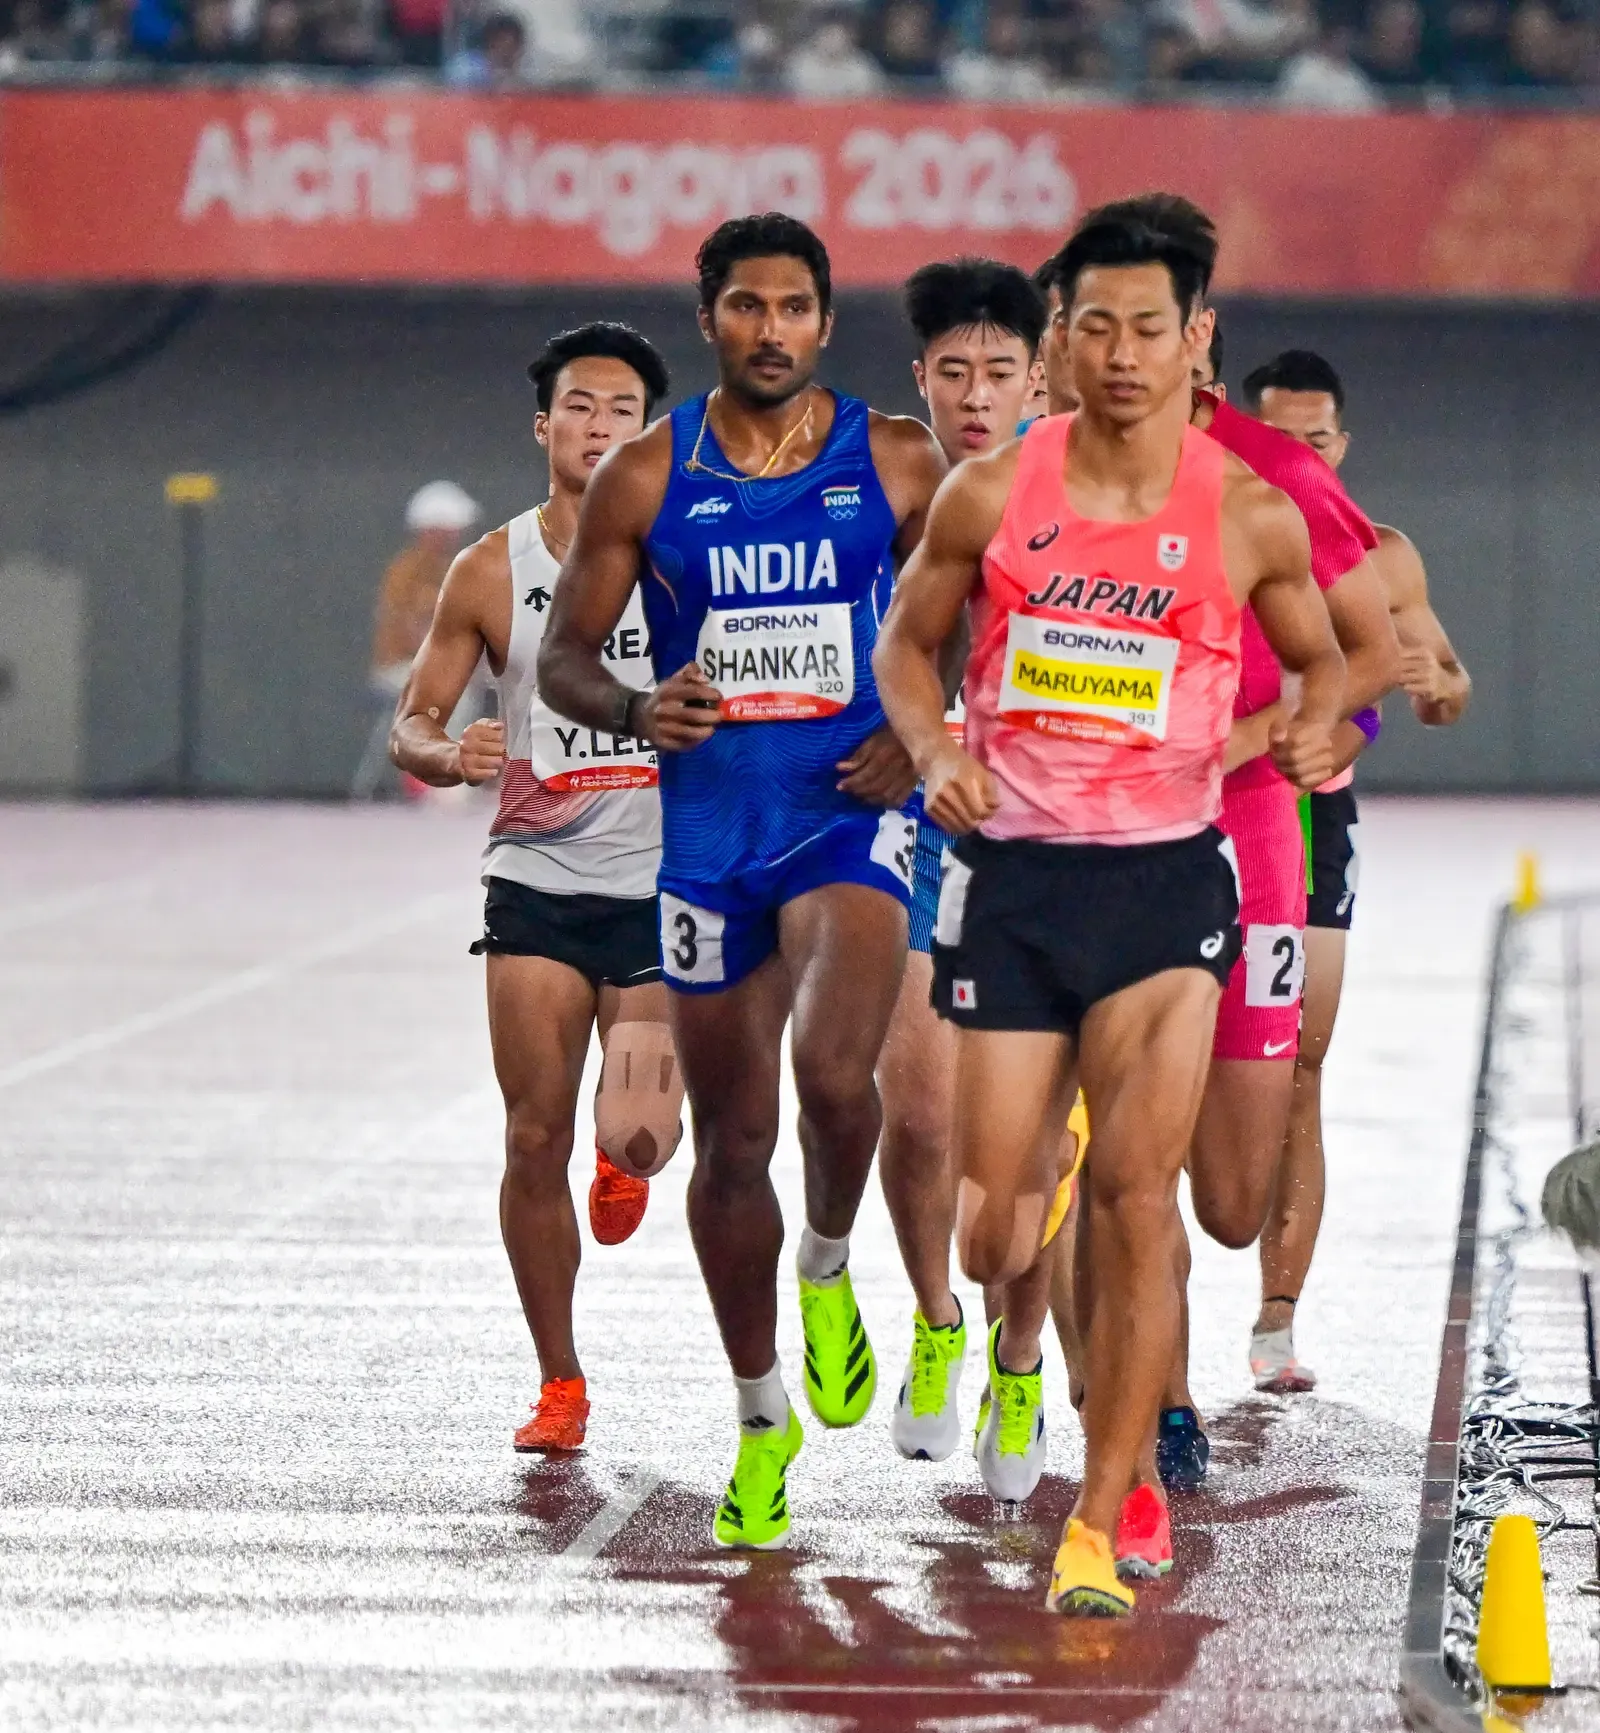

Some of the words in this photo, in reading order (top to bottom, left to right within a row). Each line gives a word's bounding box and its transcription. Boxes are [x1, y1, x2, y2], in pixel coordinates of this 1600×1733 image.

[181, 108, 823, 254] Aichi-Nagoya
[842, 129, 1075, 229] 2026
[684, 496, 732, 518] JSW
[823, 494, 861, 507] INDIA
[708, 538, 838, 597] INDIA
[1027, 574, 1175, 620] JAPAN
[723, 612, 818, 634] BORNAN
[1043, 628, 1144, 656] BORNAN
[703, 643, 841, 683] SHANKAR
[815, 681, 844, 694] 320
[1018, 661, 1154, 700] MARUYAMA
[1127, 711, 1156, 727] 393
[581, 779, 630, 787] Aichi-Nagoya
[631, 776, 650, 784] 2026
[673, 912, 697, 972] 3
[1269, 935, 1295, 997] 2
